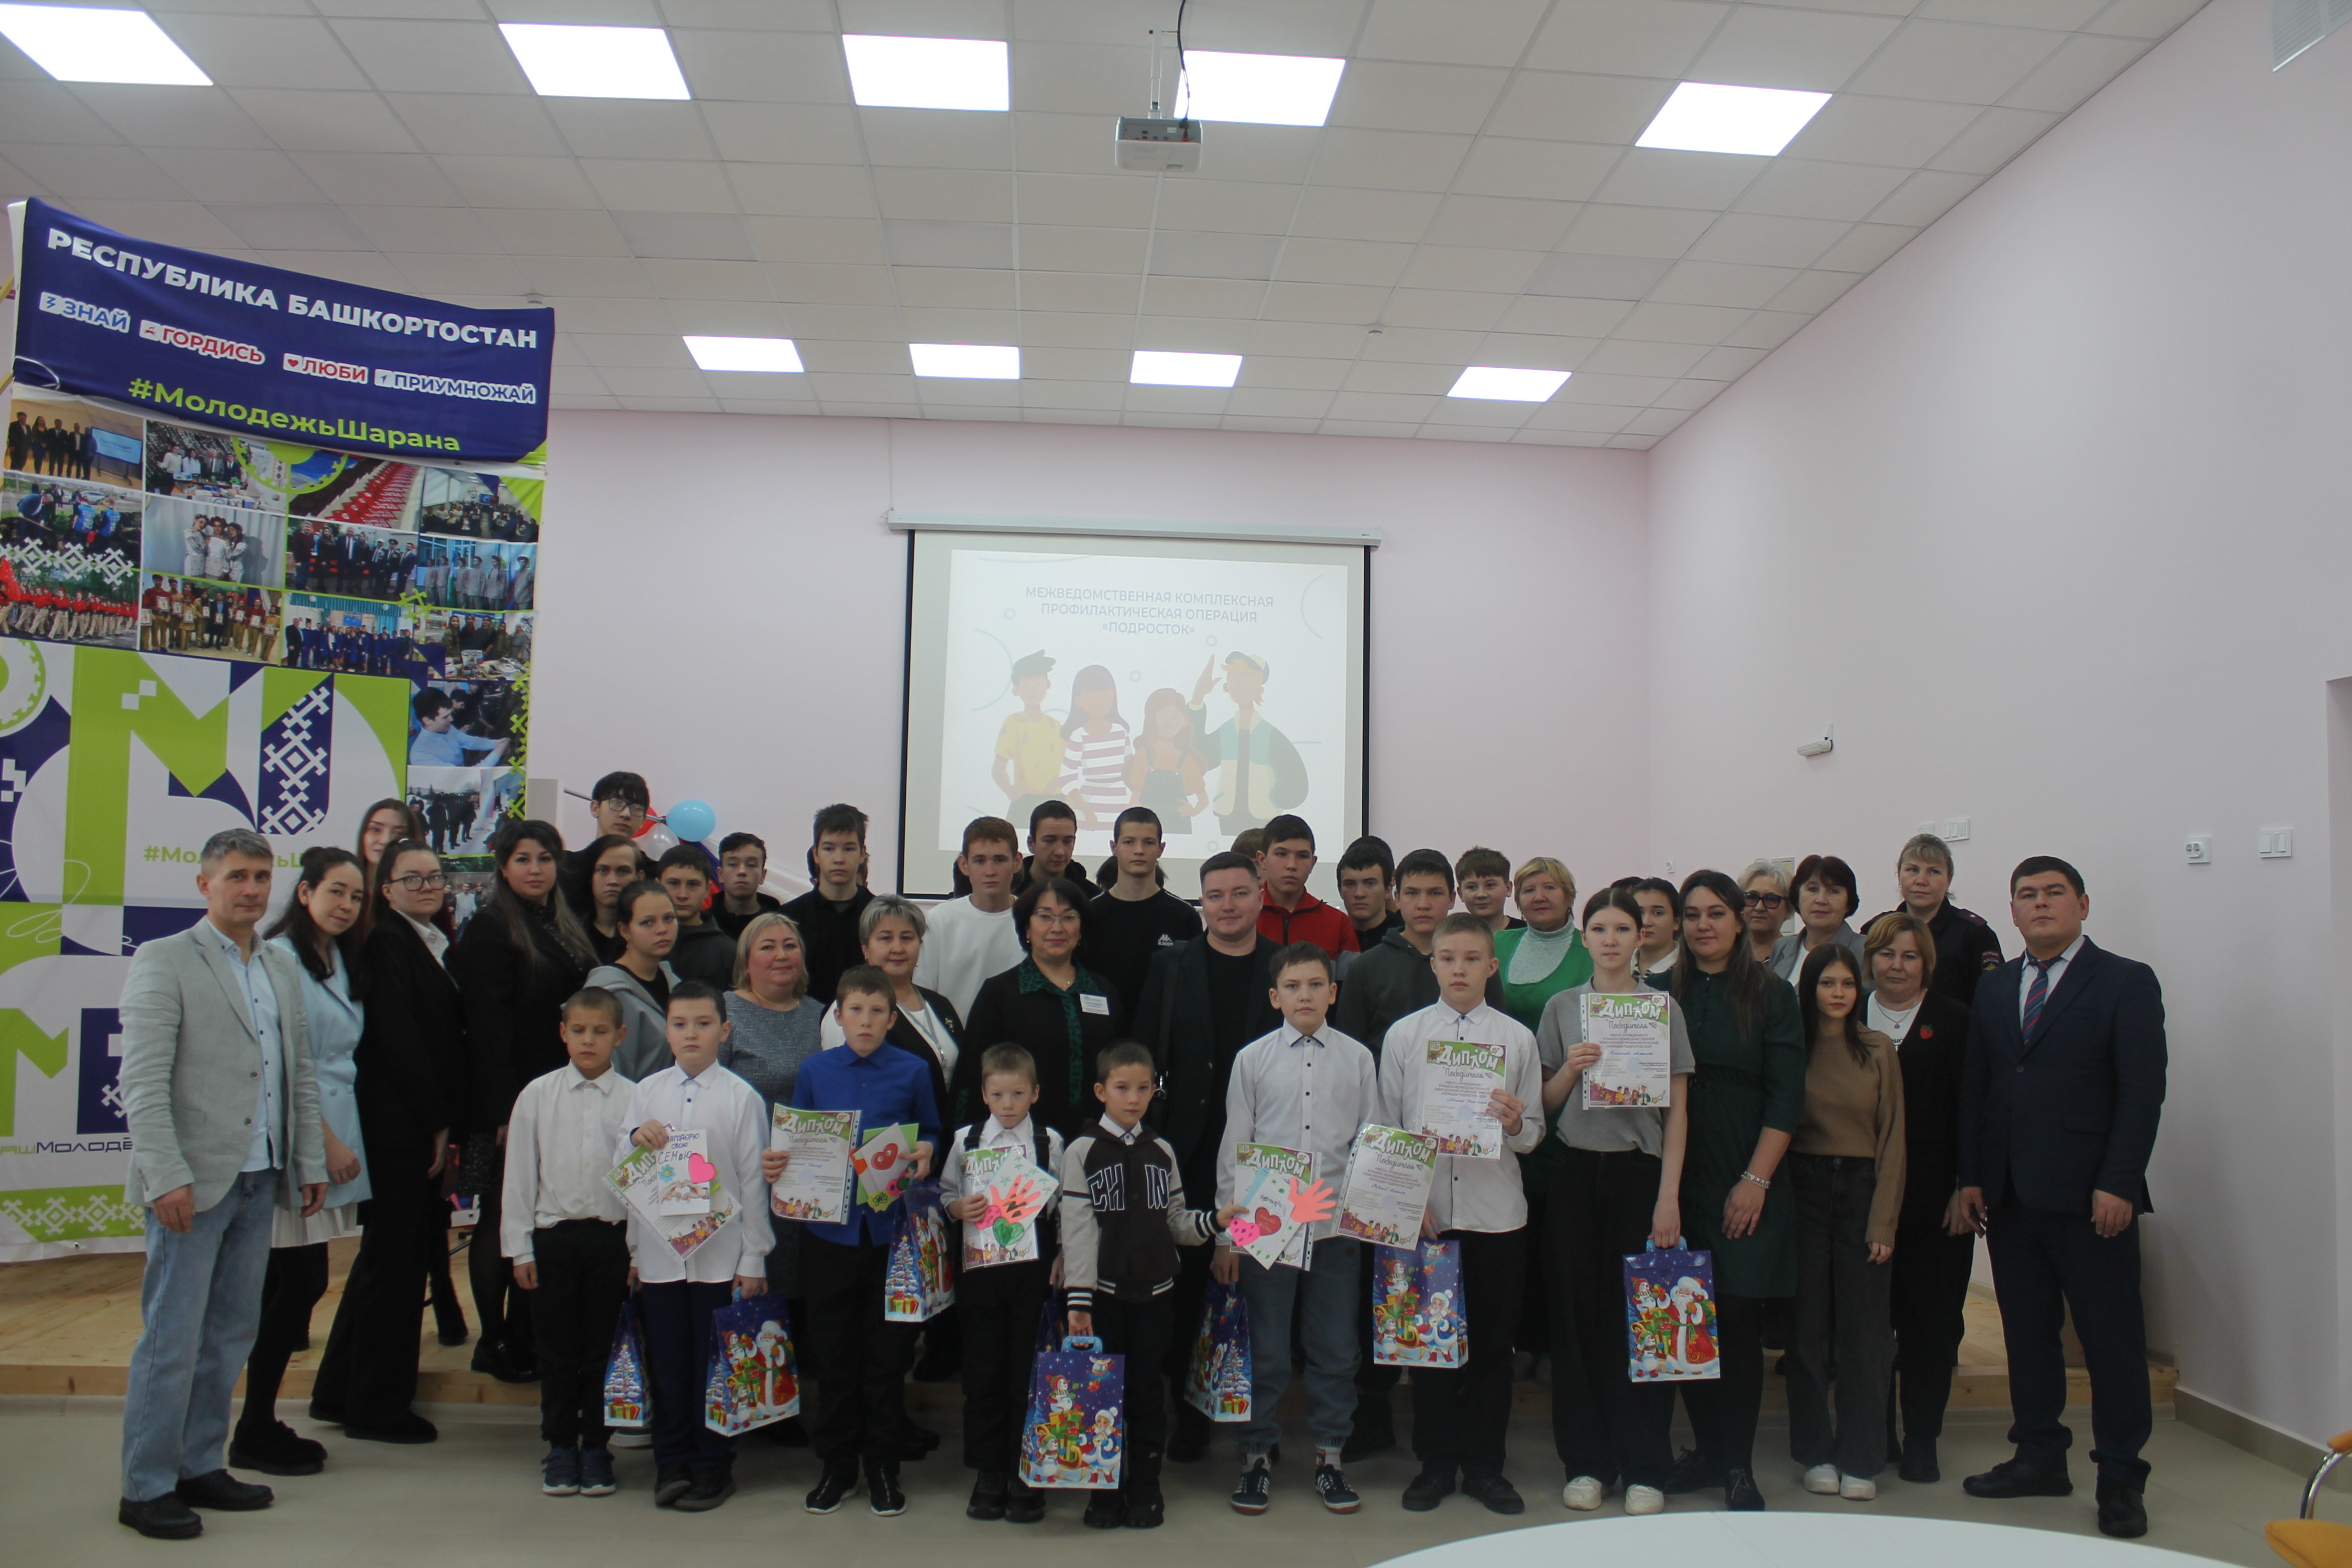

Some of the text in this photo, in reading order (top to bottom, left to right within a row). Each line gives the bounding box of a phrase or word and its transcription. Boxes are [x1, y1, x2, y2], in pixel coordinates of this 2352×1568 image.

[48, 228, 536, 349] РЕСПУБЛИКА БАШКОРТОСТАН
[63, 300, 533, 402] ЗНАЙ ГОРДИСЬ ЛЮБИ ПРИУМНОЖАЙ
[128, 378, 460, 451] #МолодежьШарана
[1026, 587, 1273, 607] МЕЖВЕДОМСТВЕННАЯ КОМПЛЕКСНАЯ
[1041, 603, 1257, 623] ПРОФИЛАКТИЧЕСКАЯ ОПЕРАЦИЯ
[1102, 622, 1195, 635] «ПОДРОСТОК»
[1609, 1021, 1648, 1033] Победителя
[1445, 1068, 1484, 1081] Победителя
[624, 1152, 656, 1186] Дип
